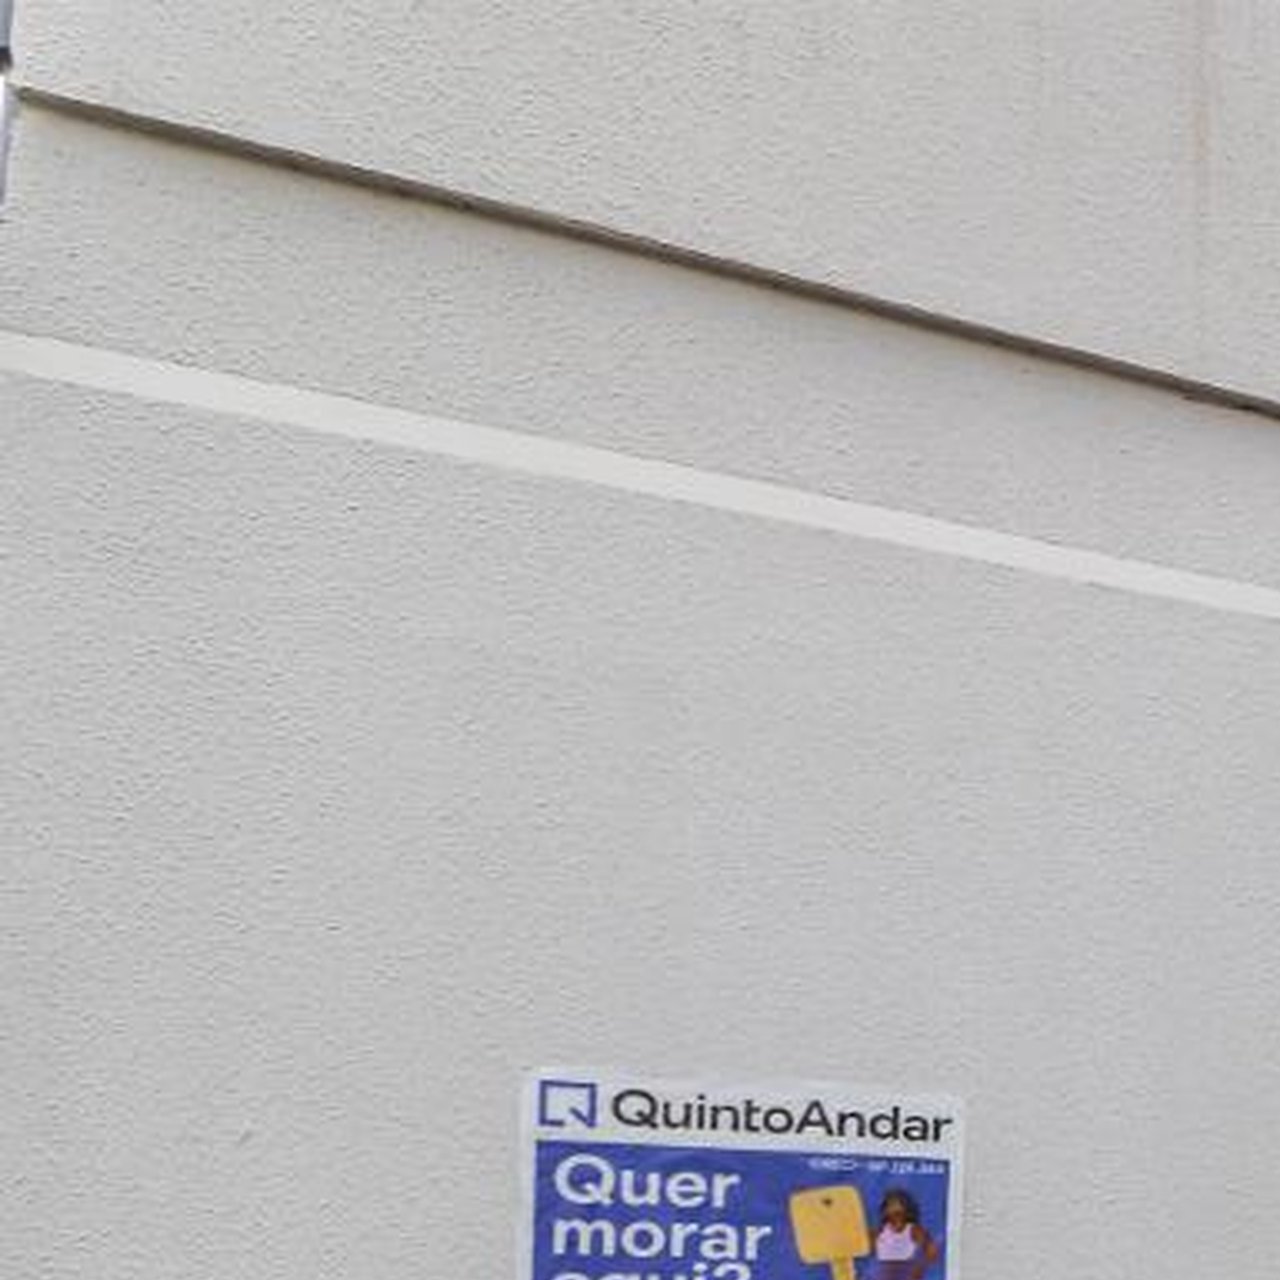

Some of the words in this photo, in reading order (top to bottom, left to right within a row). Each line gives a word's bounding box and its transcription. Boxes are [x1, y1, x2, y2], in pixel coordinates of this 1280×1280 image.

[611, 1088, 953, 1142] QuintoAndar
[553, 1154, 740, 1208] Quer
[551, 1216, 772, 1261] morar
